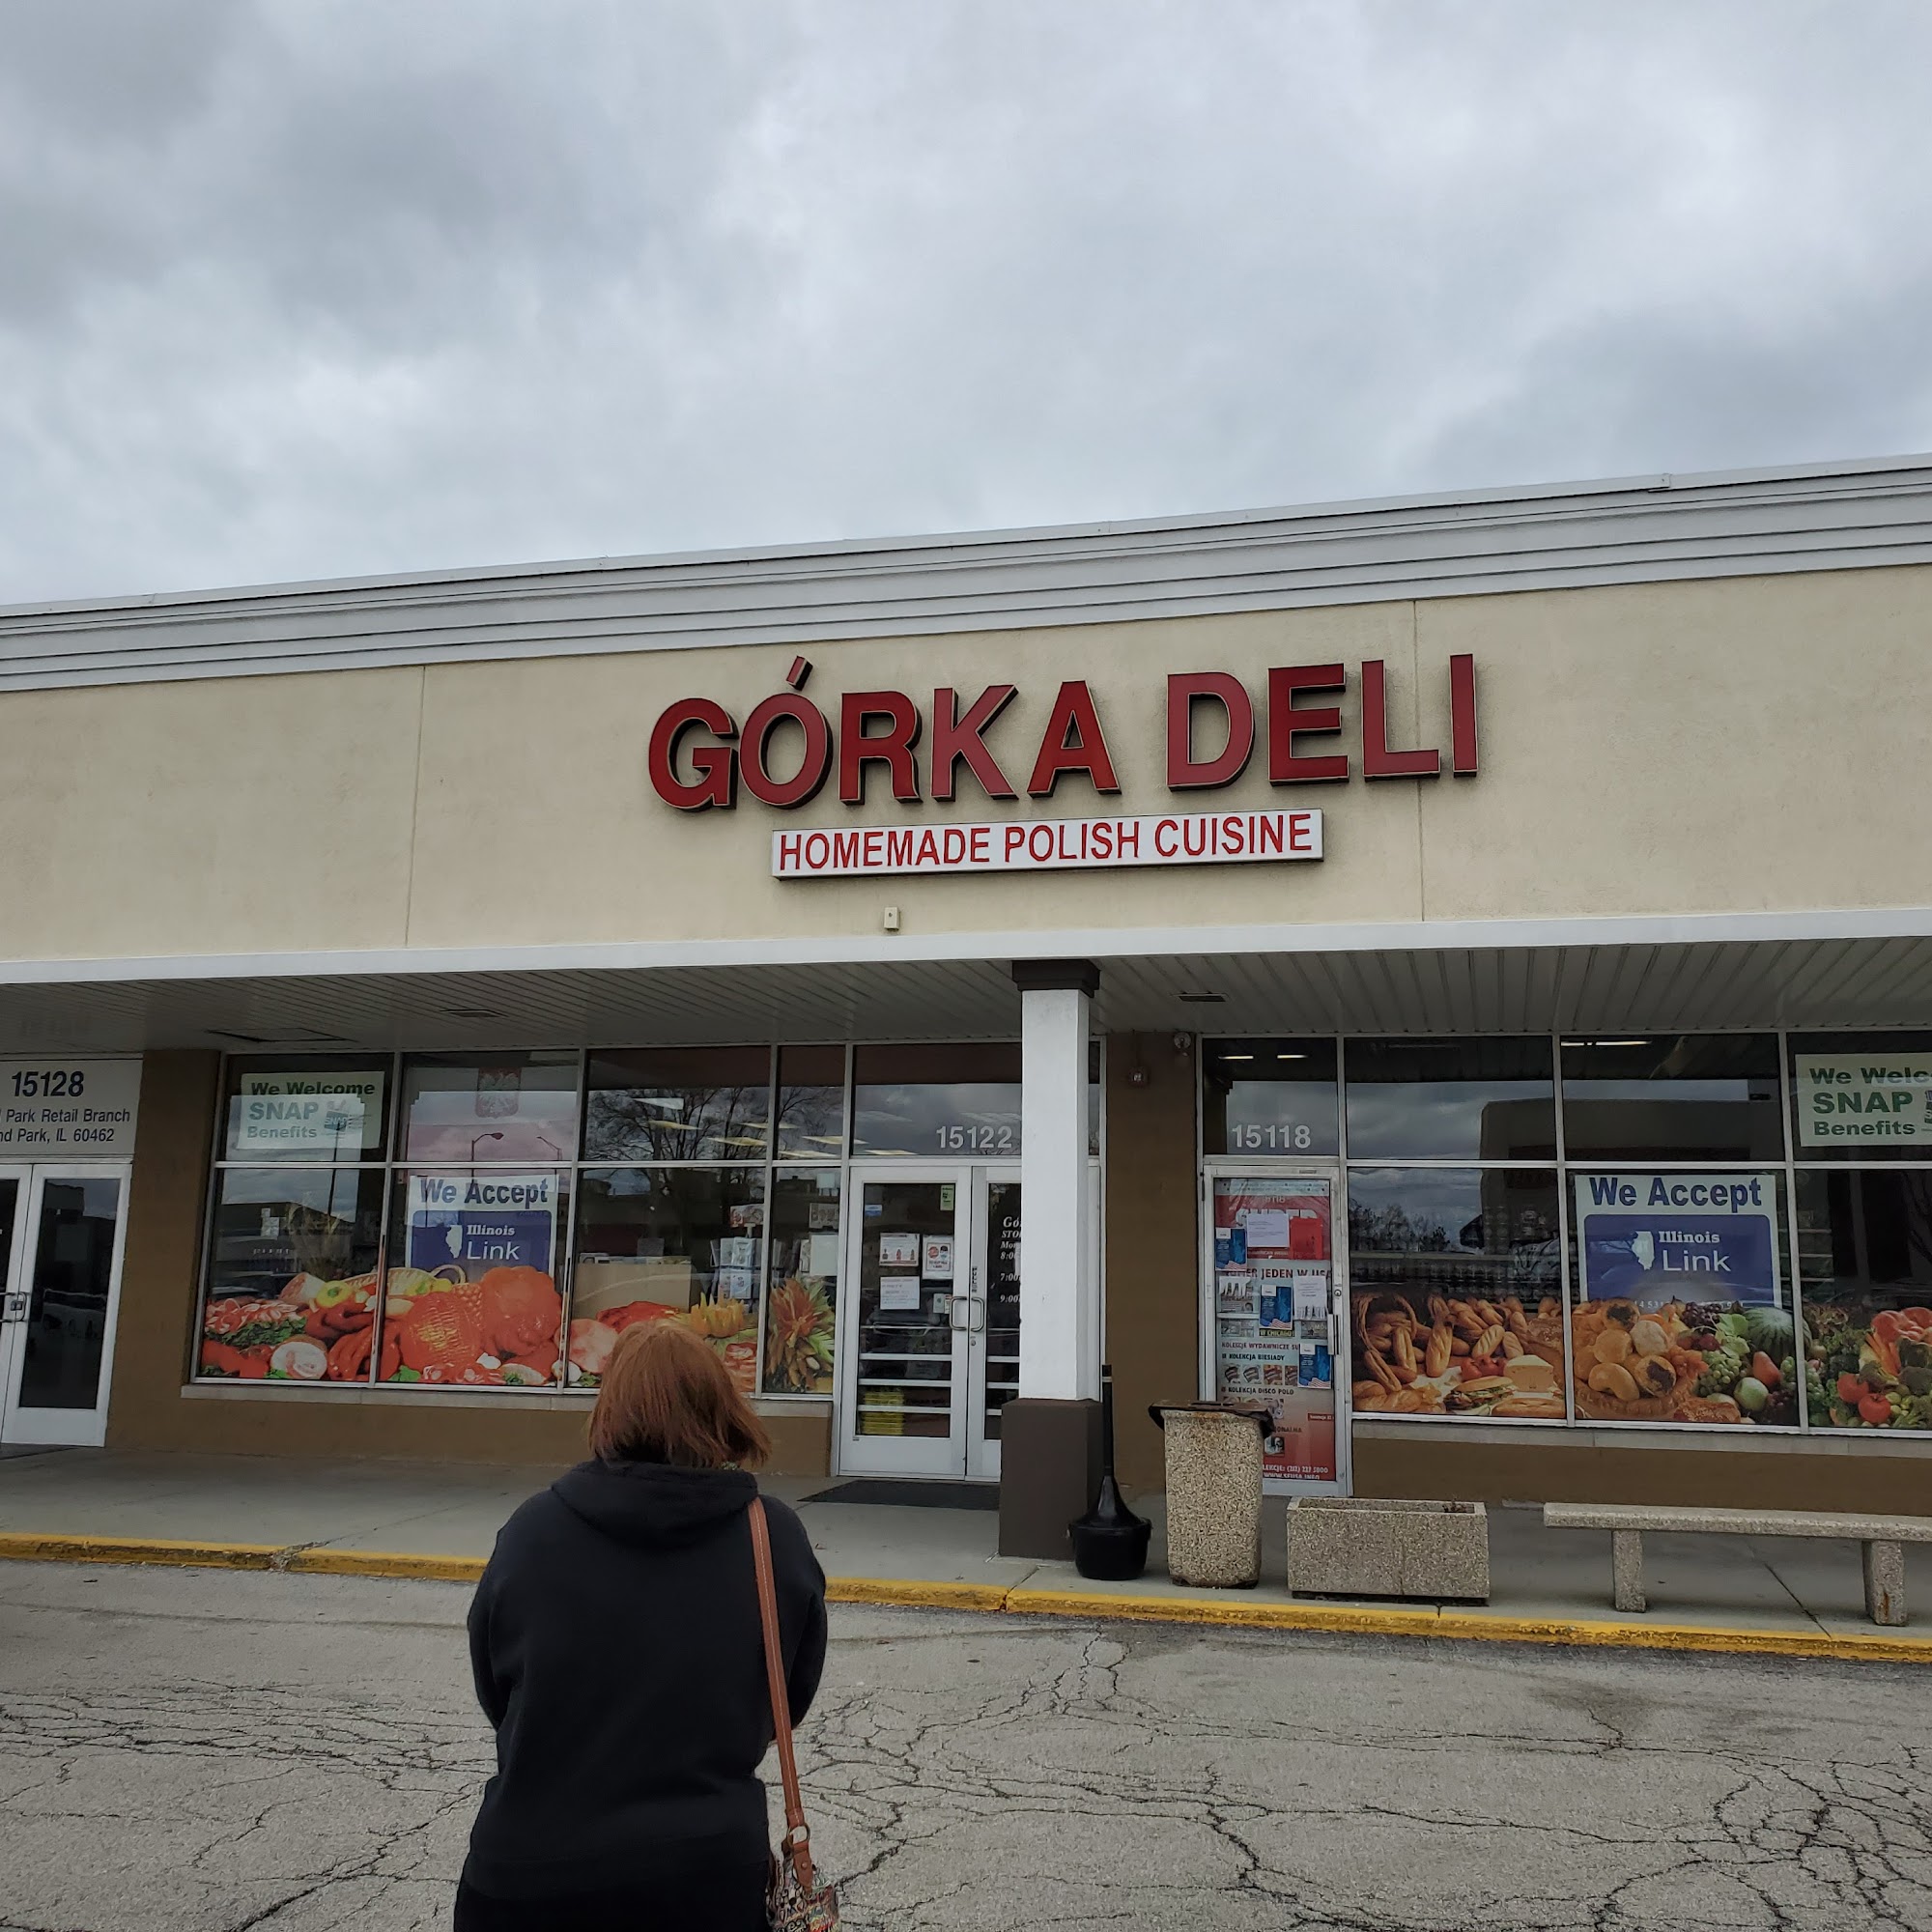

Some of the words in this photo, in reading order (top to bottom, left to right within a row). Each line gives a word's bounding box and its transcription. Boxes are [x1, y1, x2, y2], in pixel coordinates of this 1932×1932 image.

[648, 656, 1122, 810] GÓRKA
[1166, 653, 1480, 792] DELI
[779, 828, 991, 870] HOMEMADE
[1004, 822, 1140, 863] POLISH
[1154, 813, 1313, 858] CUISINE
[12, 1070, 84, 1097] 15128
[1809, 1067, 1852, 1085] We
[1861, 1066, 1932, 1084] Welc
[251, 1082, 280, 1095] We
[286, 1081, 375, 1095] Welcome
[249, 1101, 319, 1121] SNAP
[1812, 1091, 1914, 1114] SNAP
[6, 1108, 35, 1122] Park
[42, 1108, 78, 1122] Retail
[83, 1108, 130, 1122] Branch
[17, 1128, 50, 1144] Park,
[56, 1127, 67, 1142] IL
[73, 1128, 115, 1142] 60462
[247, 1125, 317, 1139] Benefits
[936, 1125, 1013, 1150] 15122
[1232, 1124, 1311, 1149] 15118
[1813, 1121, 1916, 1136] Benefits
[420, 1179, 457, 1204] We
[464, 1178, 549, 1209] Accept
[1589, 1177, 1637, 1207] We
[1647, 1177, 1763, 1213] Accept
[466, 1224, 516, 1236] Illinois
[1003, 1215, 1022, 1228] Gó
[1001, 1230, 1022, 1238] STO
[1658, 1230, 1721, 1244] Illinois
[467, 1240, 521, 1261] Link
[1662, 1249, 1732, 1273] Link
[1261, 1268, 1293, 1280] JEDEN
